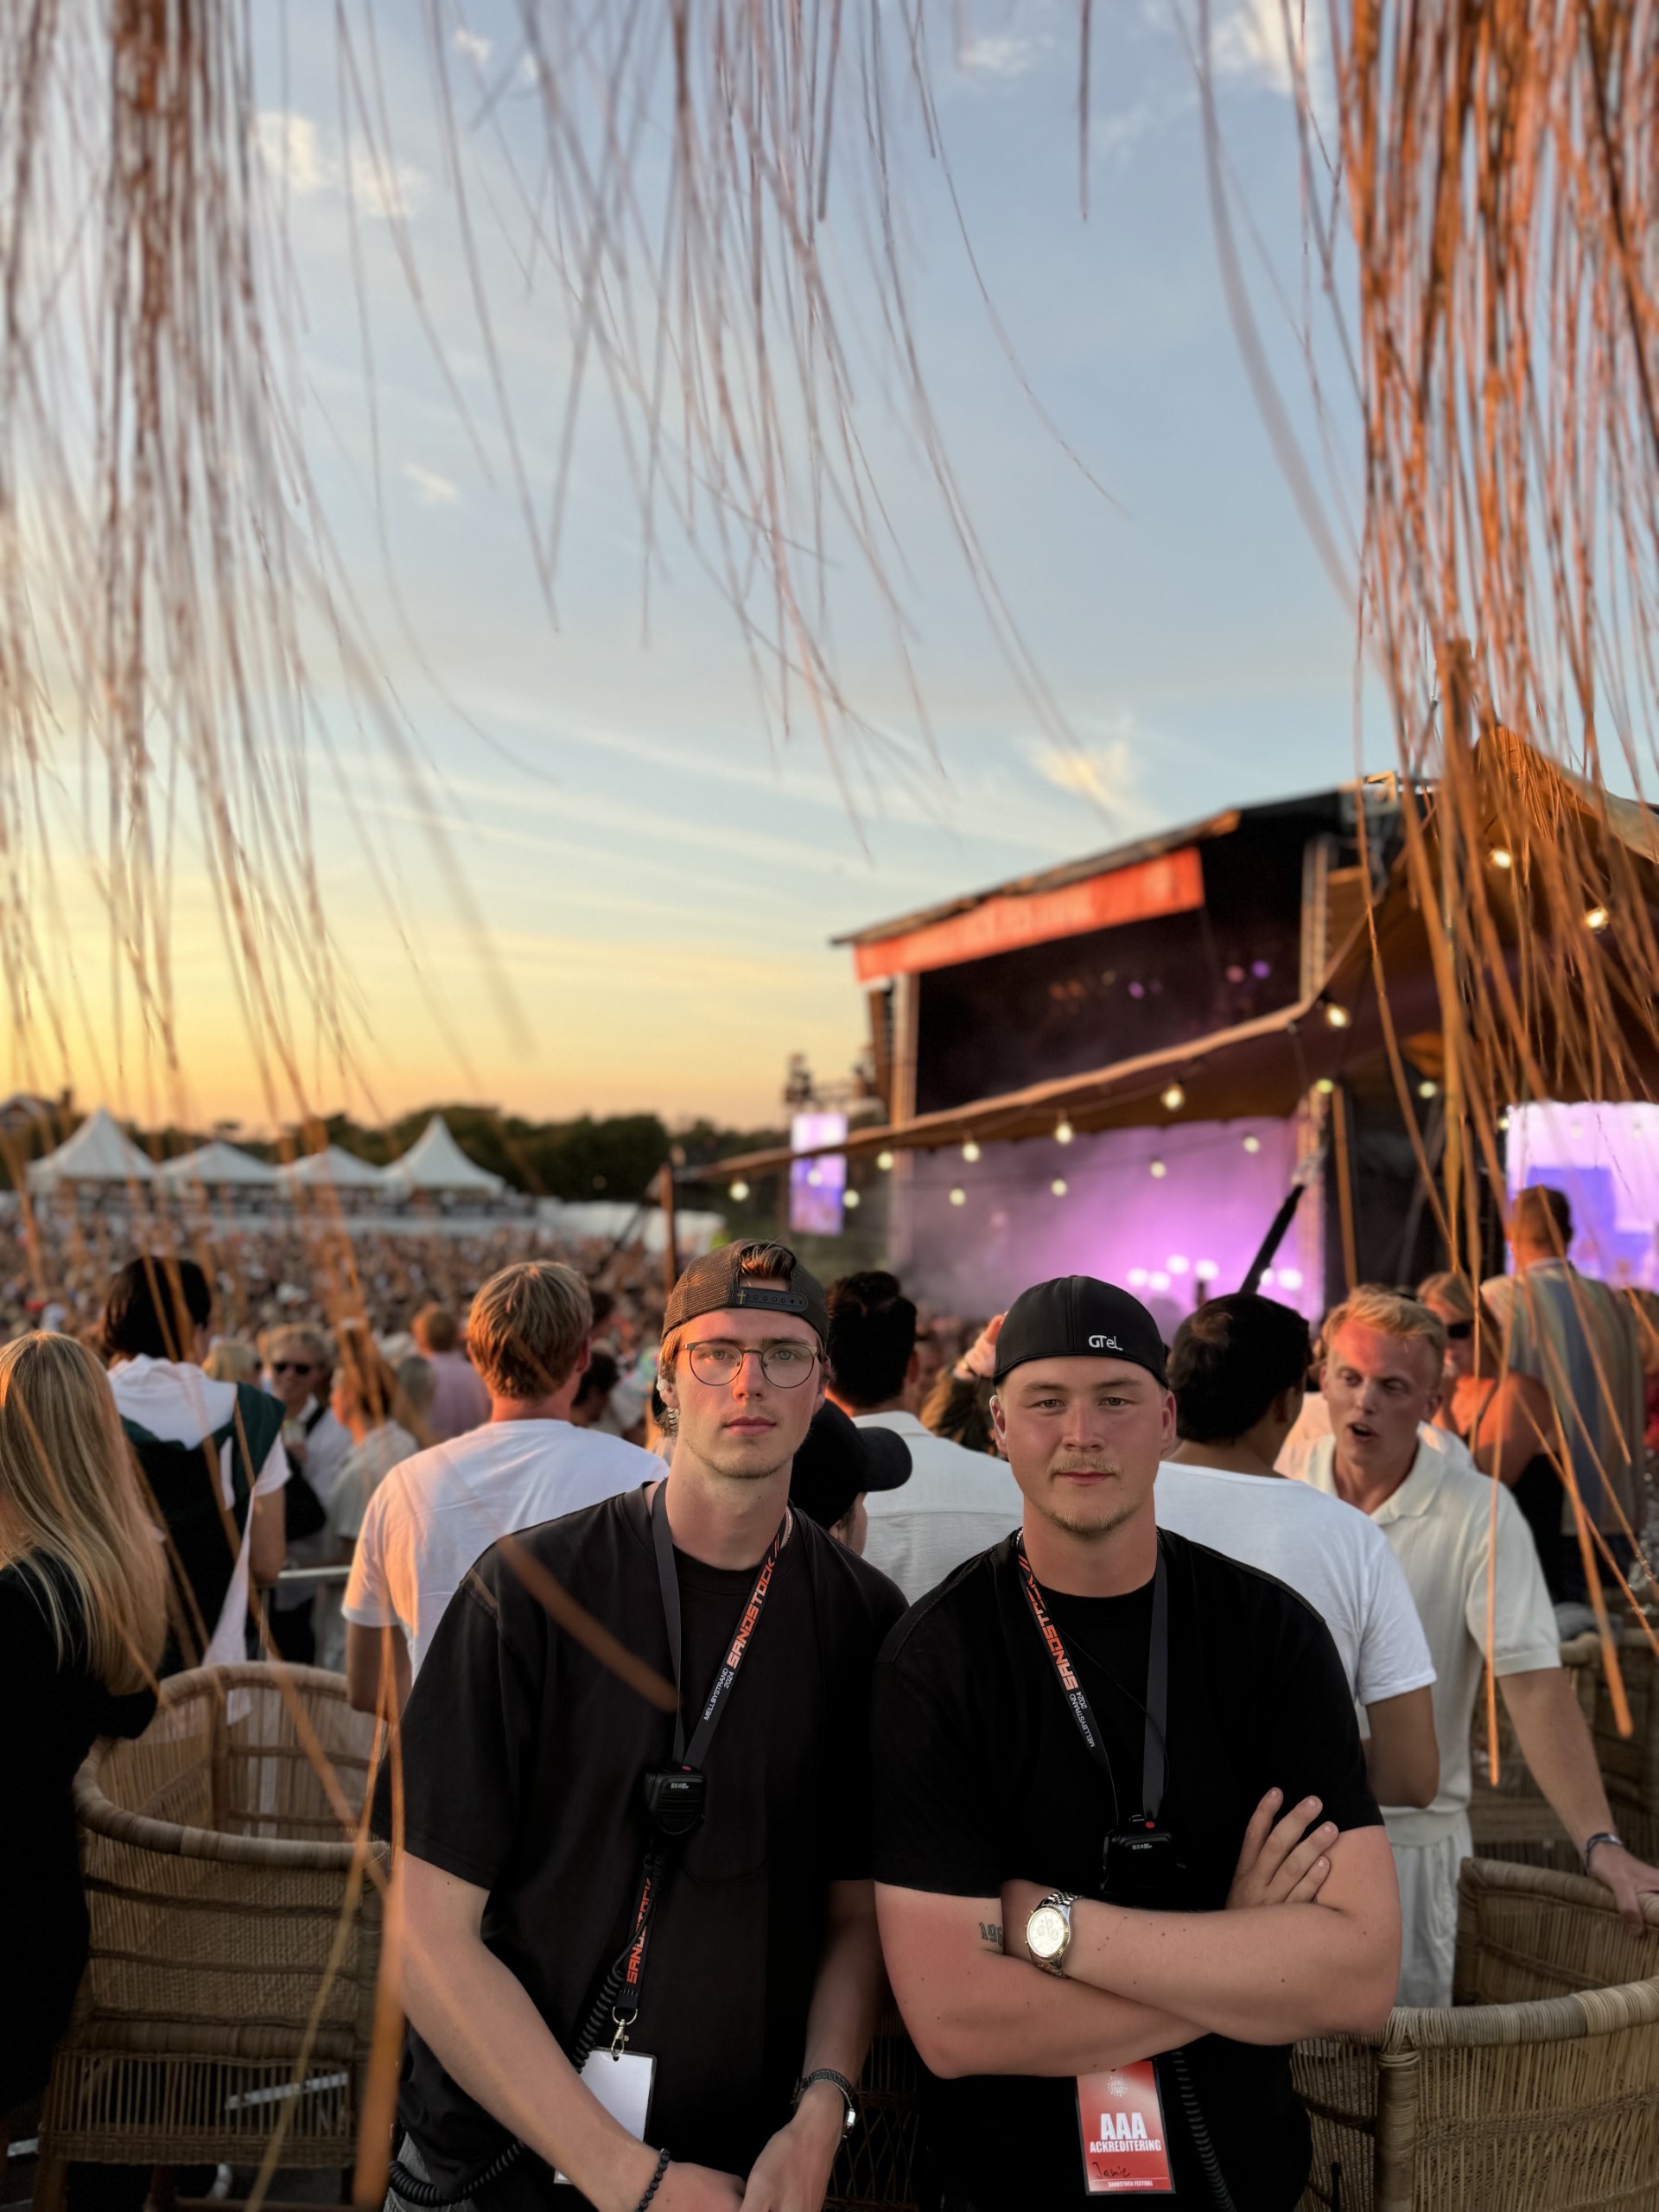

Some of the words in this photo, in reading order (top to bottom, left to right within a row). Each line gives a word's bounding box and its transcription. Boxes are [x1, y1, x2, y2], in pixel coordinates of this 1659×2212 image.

[727, 1556, 775, 1669] SANDSTOCK
[703, 1668, 728, 1721] MELLBYSTRAND
[723, 1671, 734, 1689] 2024
[1076, 1691, 1088, 1710] 2024
[1070, 1693, 1096, 1748] MELLBYSTRAND
[1101, 2112, 1147, 2141] AAA
[1090, 2139, 1162, 2153] ACKREDITERING
